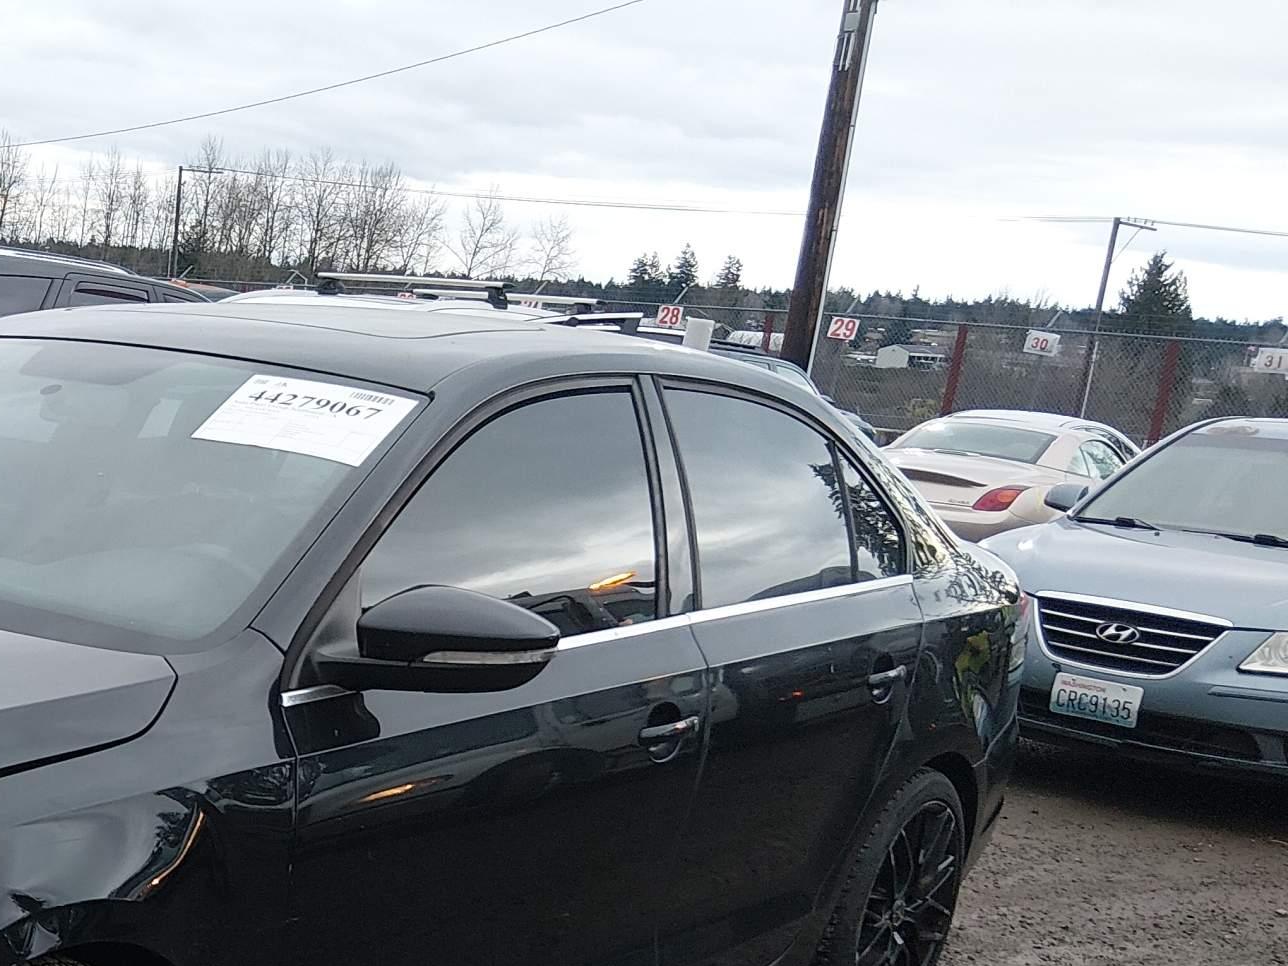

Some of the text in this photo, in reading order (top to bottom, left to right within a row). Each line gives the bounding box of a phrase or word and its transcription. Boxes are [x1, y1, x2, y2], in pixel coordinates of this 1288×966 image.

[658, 306, 681, 325] 28
[829, 318, 857, 339] 29
[1031, 337, 1049, 350] 30
[1264, 354, 1283, 369] 31
[248, 390, 383, 420] 44279067
[1056, 688, 1133, 720] CRC9135
